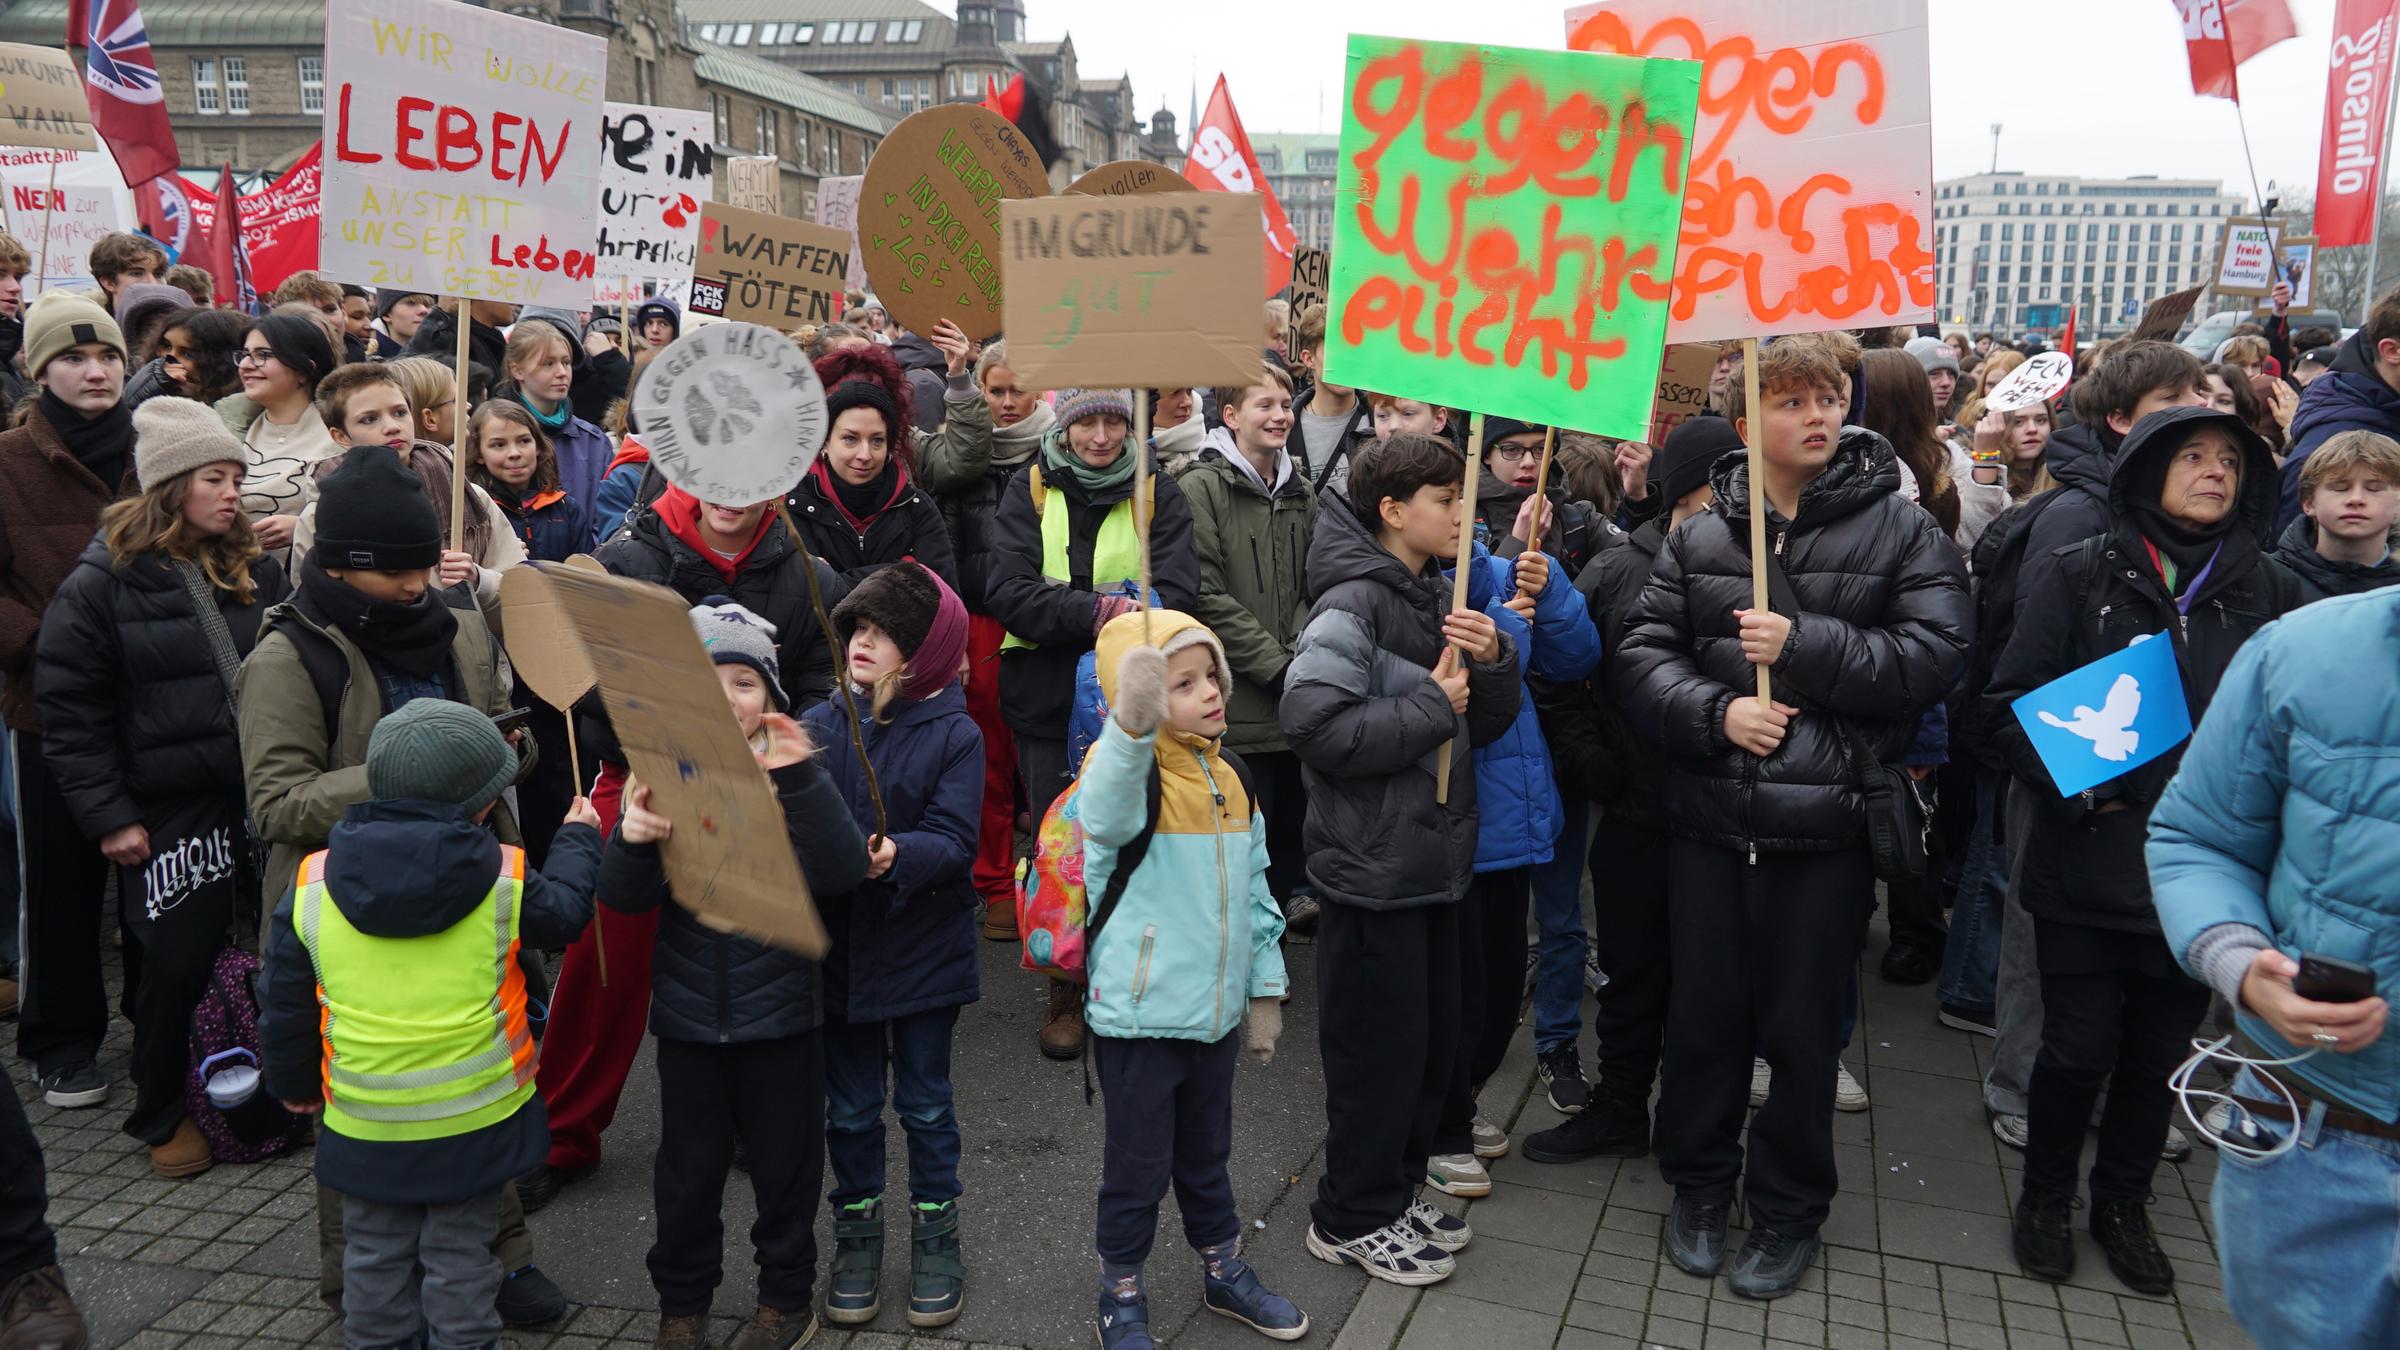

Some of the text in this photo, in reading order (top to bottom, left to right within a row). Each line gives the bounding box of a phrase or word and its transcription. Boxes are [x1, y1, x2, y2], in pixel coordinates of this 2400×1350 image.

[8, 104, 85, 136] WAHL
[335, 82, 572, 188] LEBEN
[1352, 44, 1685, 202] gegen
[0, 150, 79, 168] tadtteil!
[361, 184, 527, 231] ANSTATT
[602, 187, 655, 216] ur
[906, 174, 938, 211] IN
[927, 201, 969, 254] DICH
[1678, 159, 1852, 253] ehr
[342, 219, 596, 281] UNSER Leben
[723, 224, 850, 280] WAFFEN
[890, 234, 930, 280] LG
[1012, 215, 1062, 260] IM
[1357, 170, 1672, 312] Wehr
[2236, 231, 2269, 242] NATO
[2236, 244, 2263, 256] freie
[445, 267, 544, 301] GEBEN
[693, 283, 724, 301] FCK
[2223, 267, 2267, 283] Hamburg
[691, 295, 723, 311] AFD
[651, 328, 790, 405] GEGEN HASS
[2025, 359, 2069, 380] FCK
[1658, 382, 1703, 406] ssen
[646, 415, 682, 463] HIRN
[795, 400, 820, 450] HIRN
